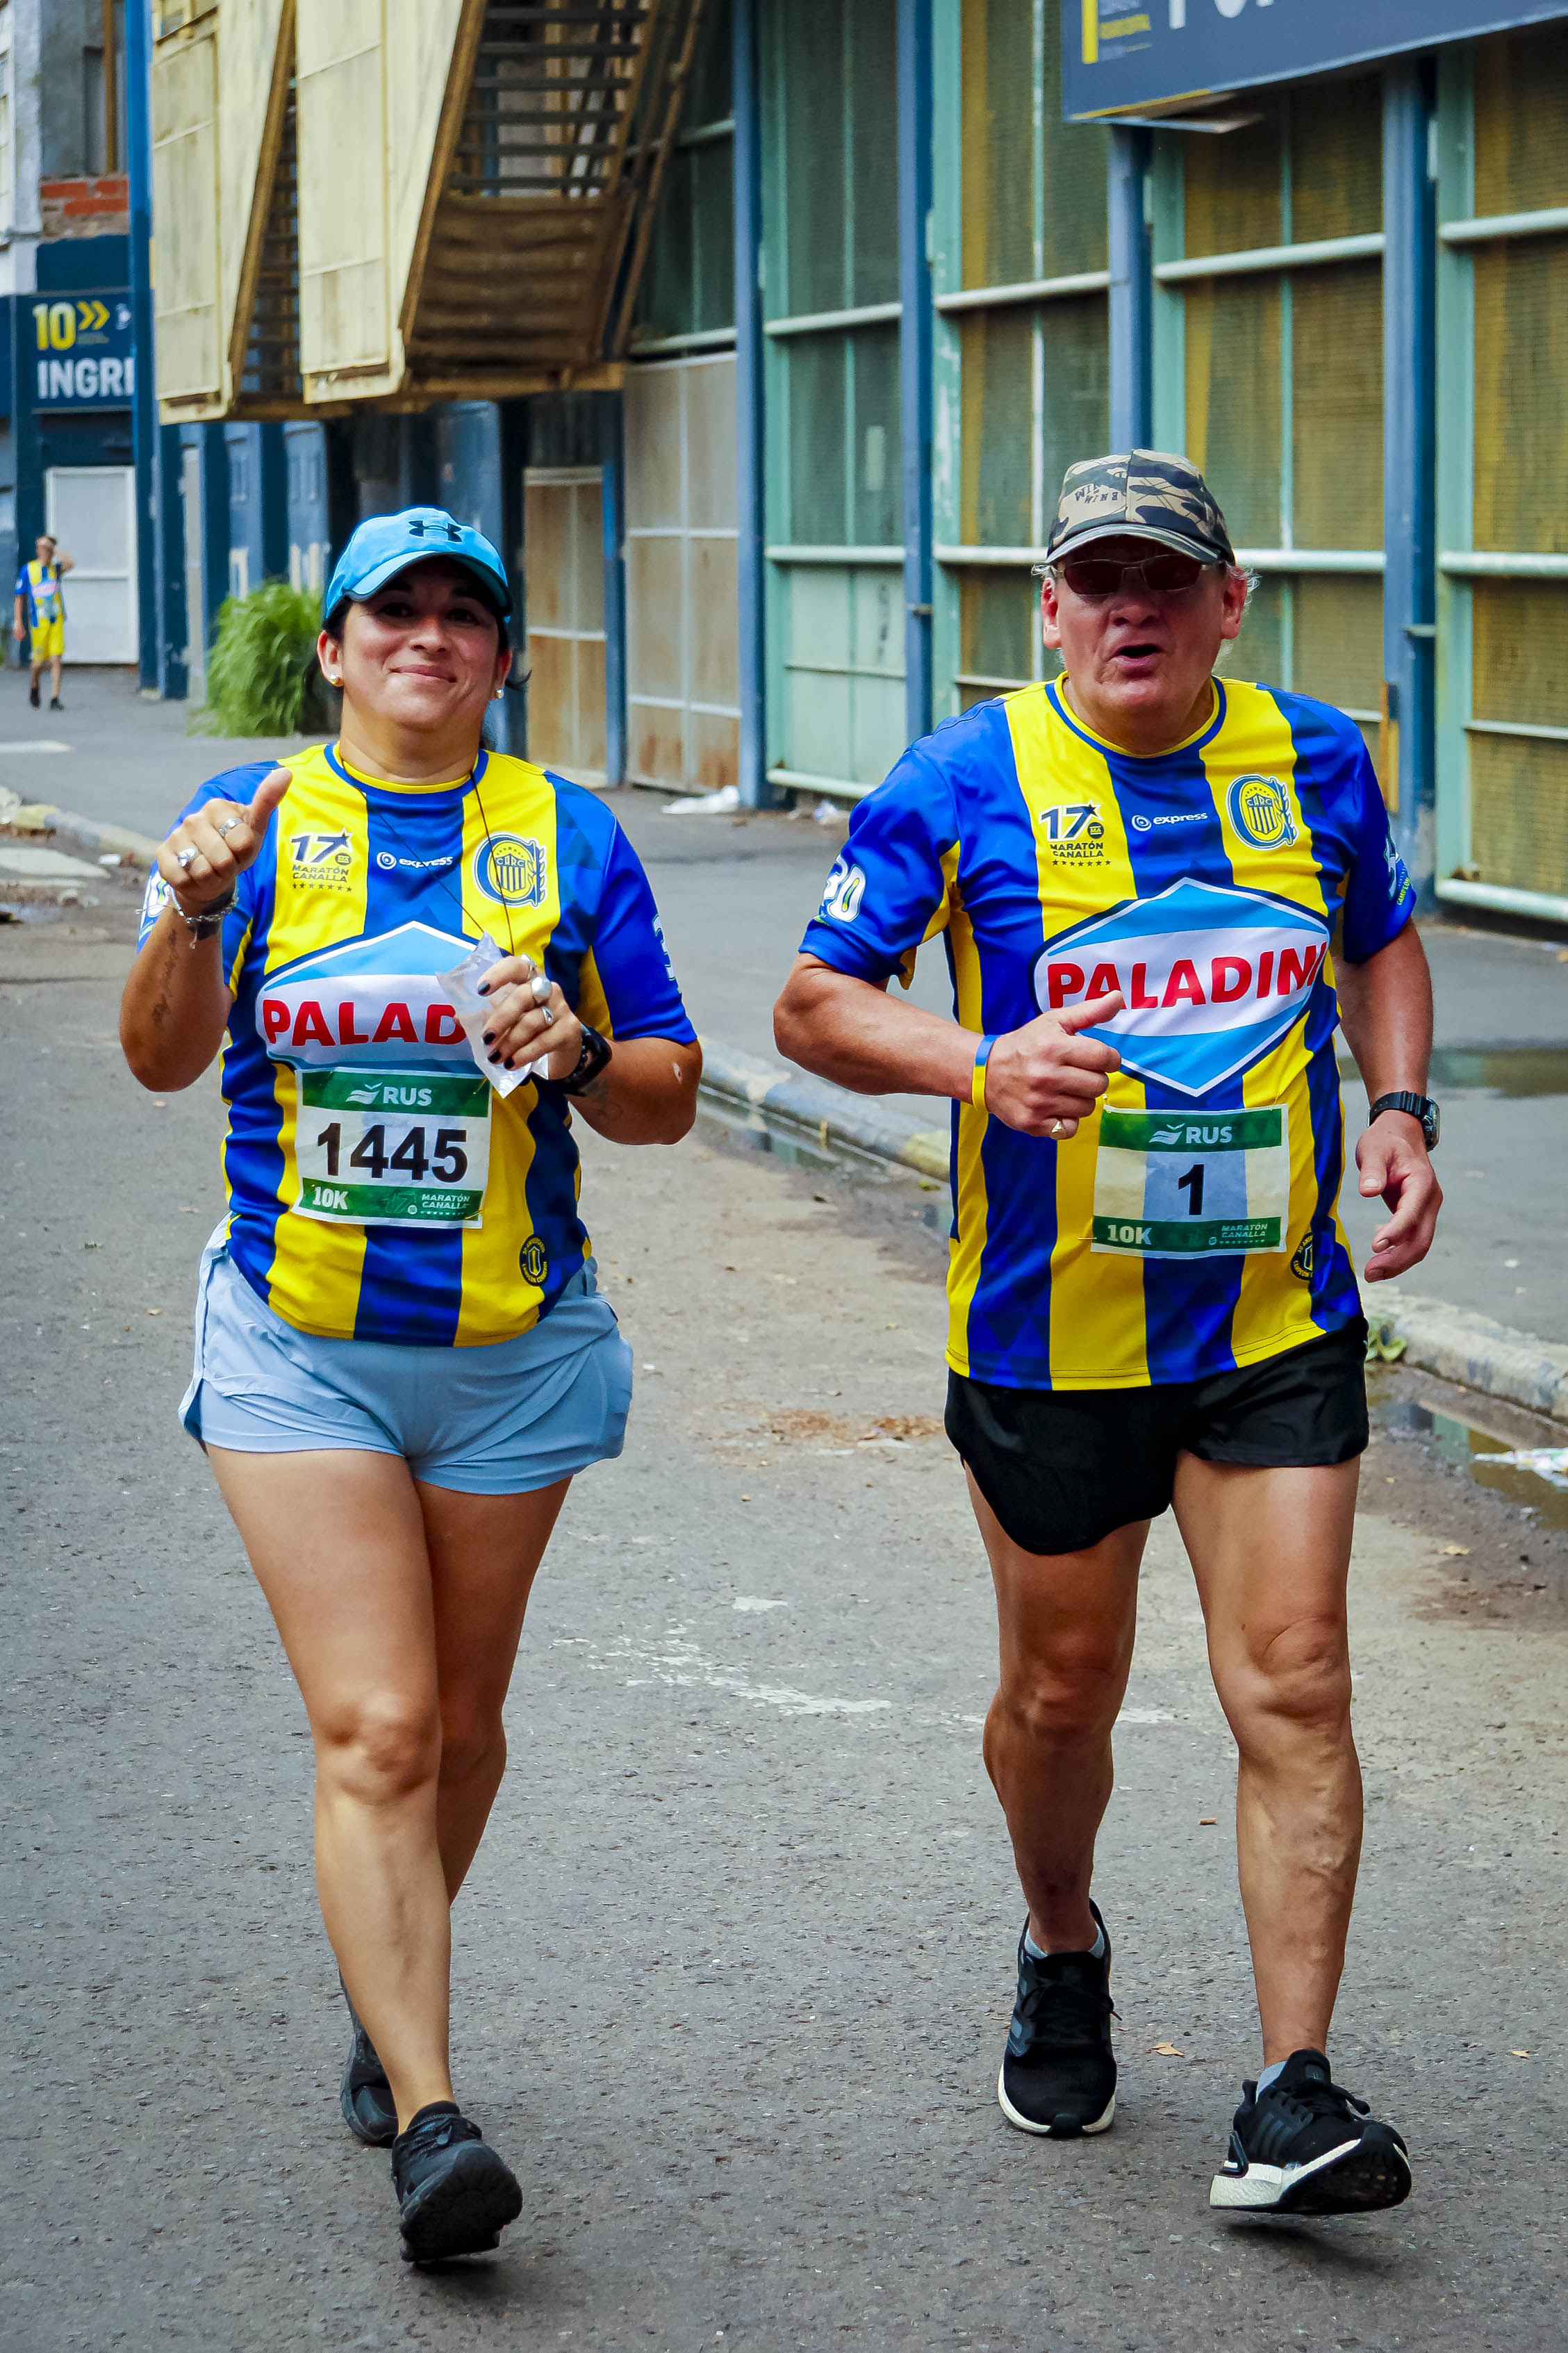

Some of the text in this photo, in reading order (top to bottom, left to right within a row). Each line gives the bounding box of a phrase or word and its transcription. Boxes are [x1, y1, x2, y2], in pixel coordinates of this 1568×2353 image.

[33, 301, 76, 350] 10
[1040, 803, 1100, 840] 17
[1153, 812, 1208, 825] express
[290, 831, 350, 864] 17
[1050, 841, 1103, 851] MARATÓN
[1053, 850, 1104, 858] CANALLA
[292, 864, 349, 876] MARATÓN
[292, 872, 347, 883] CANALLA
[383, 1086, 433, 1106] RUS
[1185, 1126, 1232, 1145] RUS
[317, 1122, 468, 1183] 1445
[313, 1186, 349, 1211] 10K
[421, 1193, 470, 1202] MARATÓN
[1178, 1163, 1205, 1216] 1
[422, 1201, 468, 1210] CANALLA
[1107, 1224, 1153, 1245] 10K
[1221, 1222, 1268, 1231] MARATÓN
